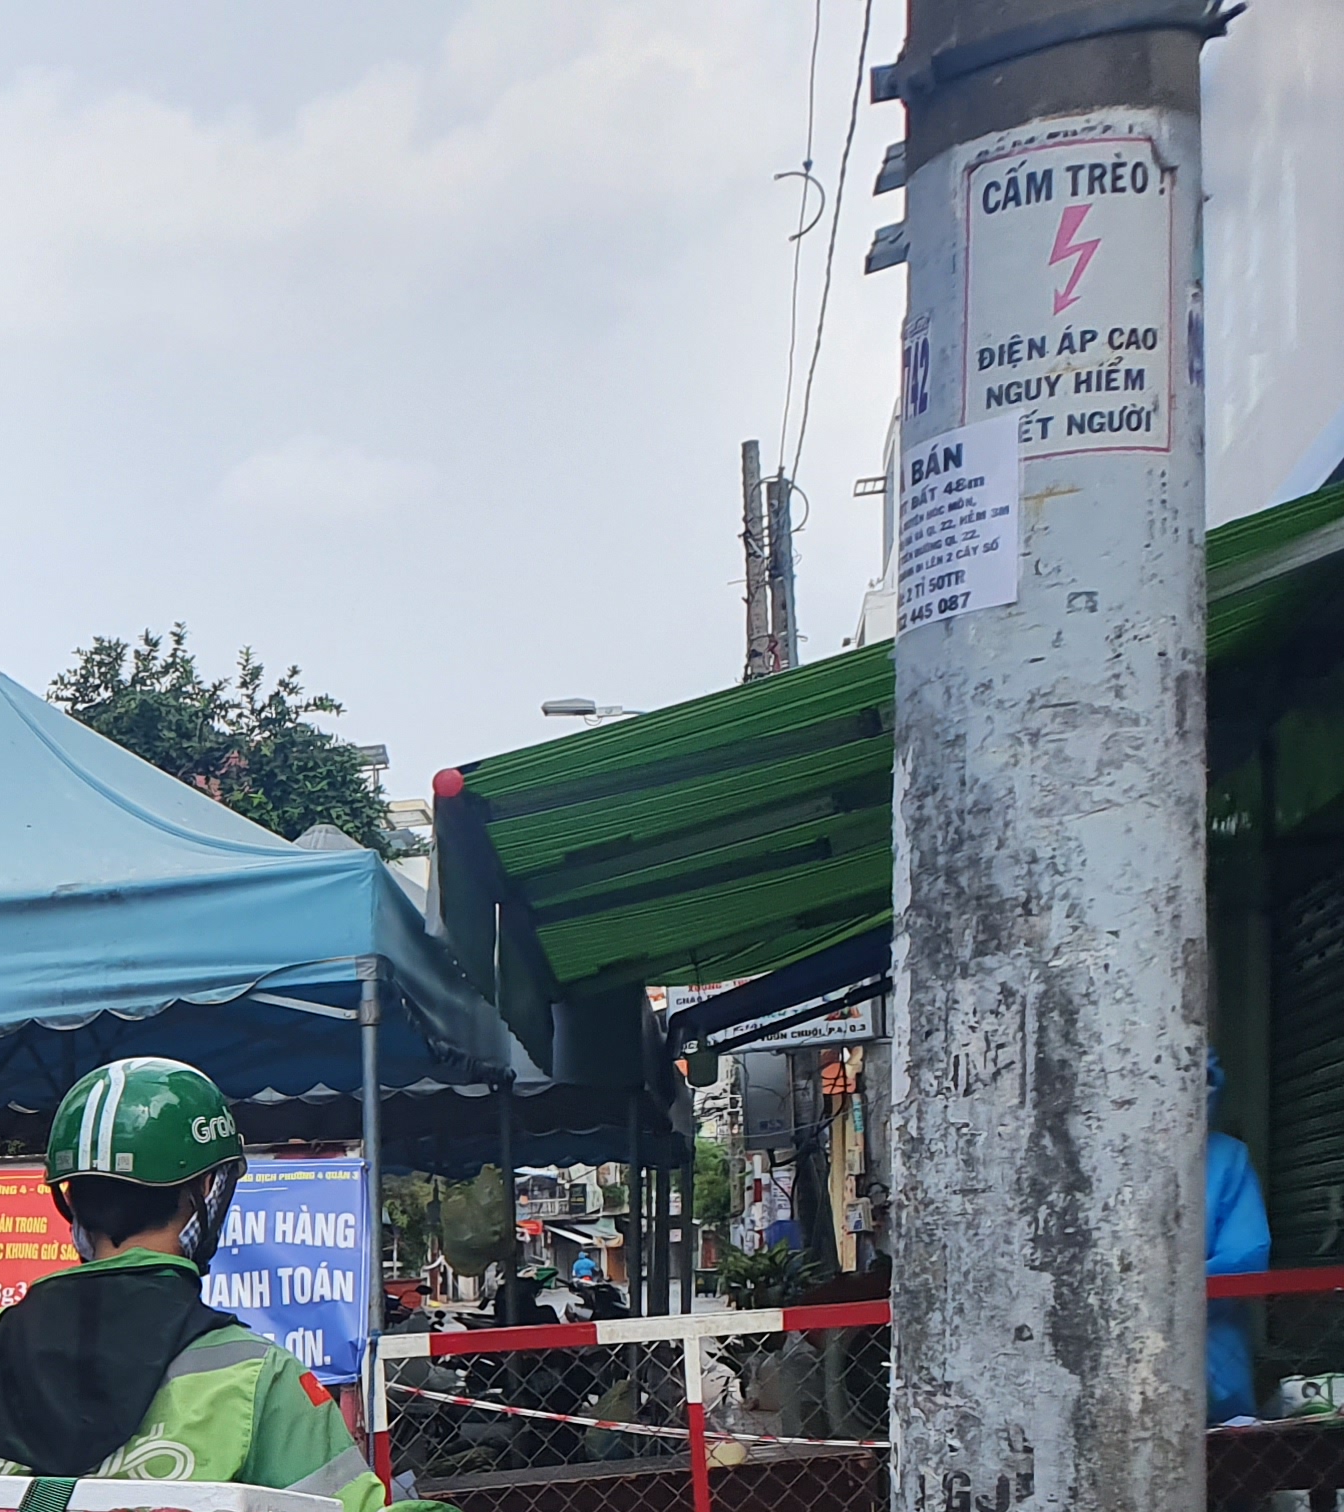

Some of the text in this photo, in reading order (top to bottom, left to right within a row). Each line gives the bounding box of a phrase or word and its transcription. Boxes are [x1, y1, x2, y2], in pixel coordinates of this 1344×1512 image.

[982, 160, 1053, 215] CẤM
[977, 324, 1159, 372] ĐIỆN ÁP CAO
[985, 356, 1146, 410] NGUY HIỂM
[1066, 402, 1157, 437] NGƯỜI
[911, 443, 963, 487] BÁN
[937, 591, 972, 615] 087
[19, 1185, 27, 1194] 4
[15, 1216, 47, 1234] TRONG
[274, 1204, 356, 1249] HÀNG
[5, 1243, 38, 1260] KHUNG
[40, 1240, 59, 1260] GIỜ
[277, 1262, 354, 1305] TOÁN
